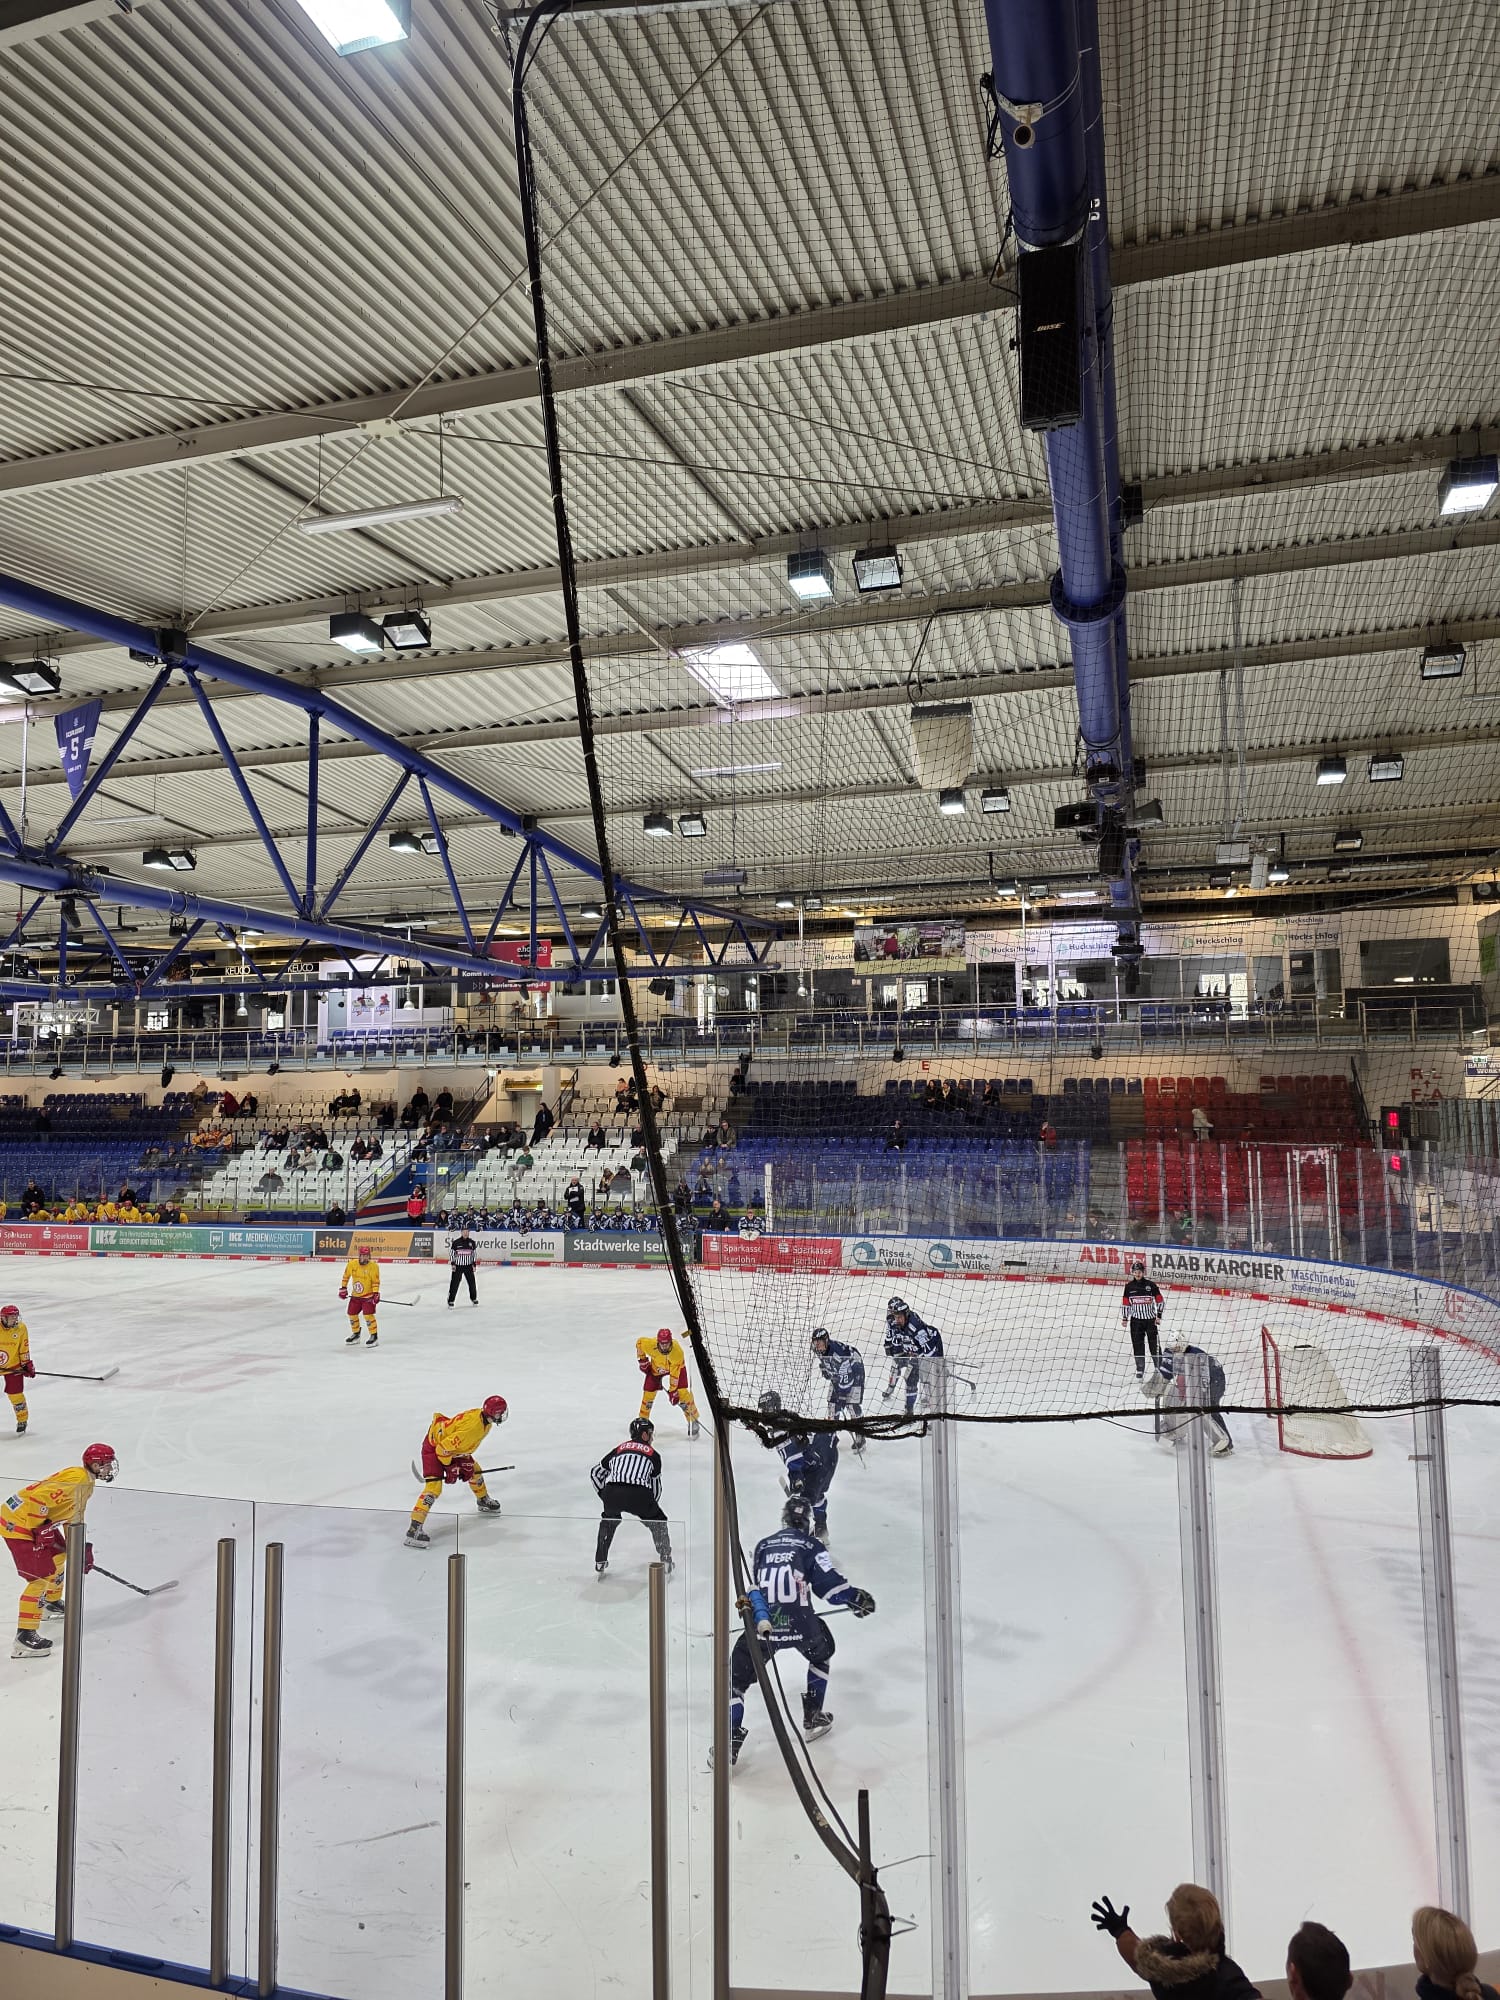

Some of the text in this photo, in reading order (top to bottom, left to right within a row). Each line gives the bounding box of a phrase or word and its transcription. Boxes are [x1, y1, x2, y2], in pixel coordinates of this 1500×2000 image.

[71, 737, 79, 760] 5
[1196, 937, 1243, 946] Huckschlag
[225, 966, 251, 976] KEUCO
[288, 963, 314, 973] KEUCO
[52, 974, 76, 983] KECO
[922, 1061, 929, 1070] E
[3, 1231, 33, 1240] Sparkasse
[53, 1232, 83, 1241] Sparkasse
[96, 1229, 118, 1245] IKZ
[245, 1232, 304, 1243] MEDIENWERKSTATT
[3, 1240, 27, 1249] Iserlohn
[53, 1241, 77, 1250] Iserlohn
[319, 1236, 347, 1249] sikla
[510, 1238, 555, 1250] Iserlohn
[573, 1239, 640, 1252] Stadtwerke
[724, 1244, 763, 1254] Sparkasse
[793, 1246, 833, 1256] Sparkasse
[724, 1255, 756, 1264] Iserlohn
[1079, 1246, 1120, 1265] ABB
[1151, 1253, 1200, 1272] RAAB
[1204, 1257, 1285, 1281] KARCHER
[1152, 1270, 1217, 1283] BAUSTOFFHANDEL
[1291, 1269, 1356, 1288] Maschinenbau
[620, 1441, 650, 1453] GEFRO
[760, 1563, 798, 1604] 40
